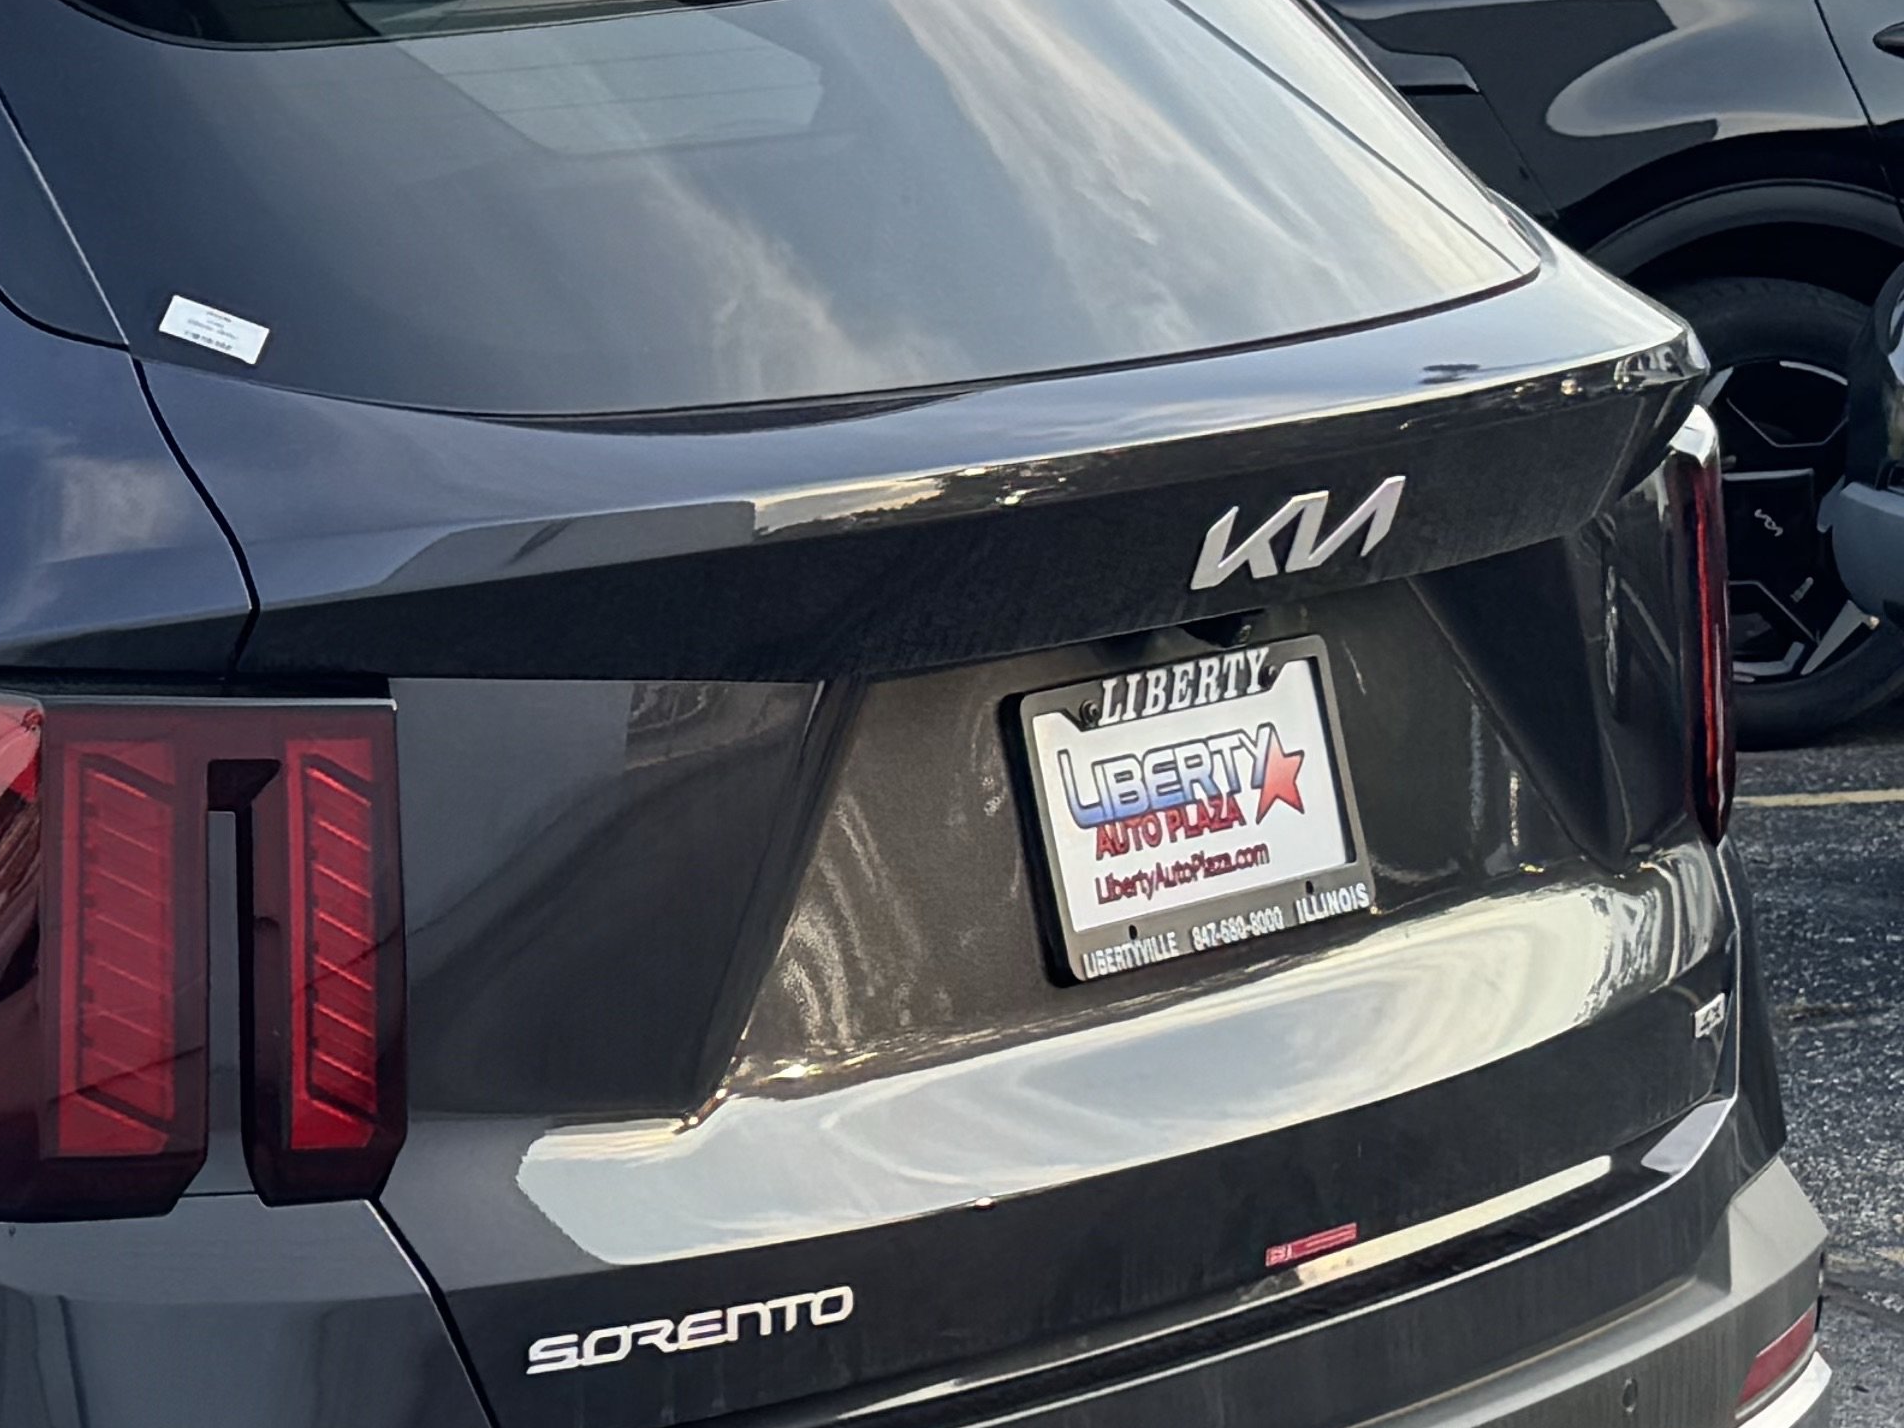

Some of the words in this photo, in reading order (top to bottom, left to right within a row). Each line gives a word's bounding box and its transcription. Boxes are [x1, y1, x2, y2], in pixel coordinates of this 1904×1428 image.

[1098, 647, 1269, 726] LIBERTY
[1057, 722, 1274, 829] LIBERTY
[1095, 811, 1163, 861] AUTO
[1166, 795, 1248, 843] PLAZA
[1095, 843, 1270, 905] LibertyAutoPlaza.com
[1083, 931, 1178, 979] LIBERTYVILLE
[1295, 882, 1371, 924] ILLINOIS
[526, 1285, 855, 1375] SORENTO
